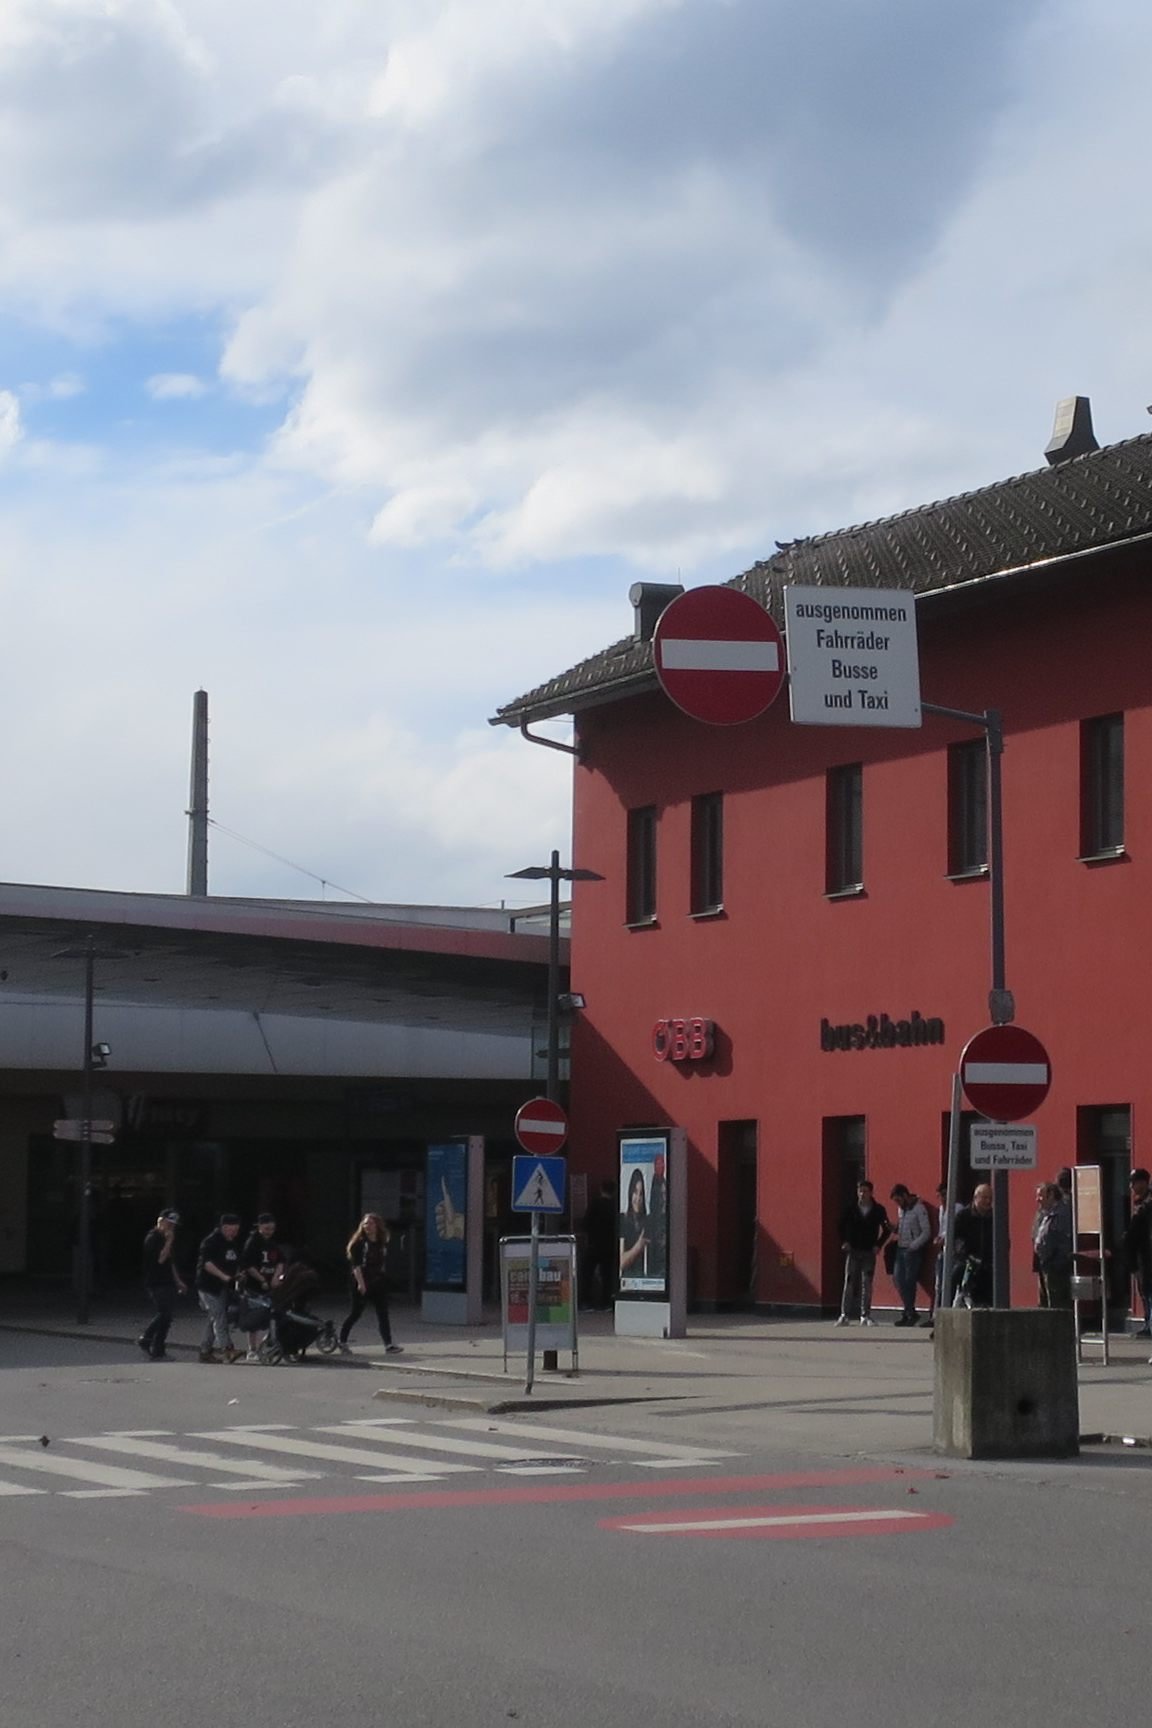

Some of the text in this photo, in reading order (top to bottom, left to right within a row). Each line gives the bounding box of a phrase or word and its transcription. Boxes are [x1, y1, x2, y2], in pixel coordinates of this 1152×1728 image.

[796, 603, 907, 623] ausgenommen
[816, 629, 890, 651] Fahrräder
[832, 659, 878, 680] Busse
[824, 689, 889, 710] und Taxi
[821, 1010, 945, 1052] bus&bahn
[974, 1129, 1034, 1138] ausgenommen
[1011, 1141, 1028, 1151] Taxi
[975, 1154, 1033, 1165] und Fahrräder
